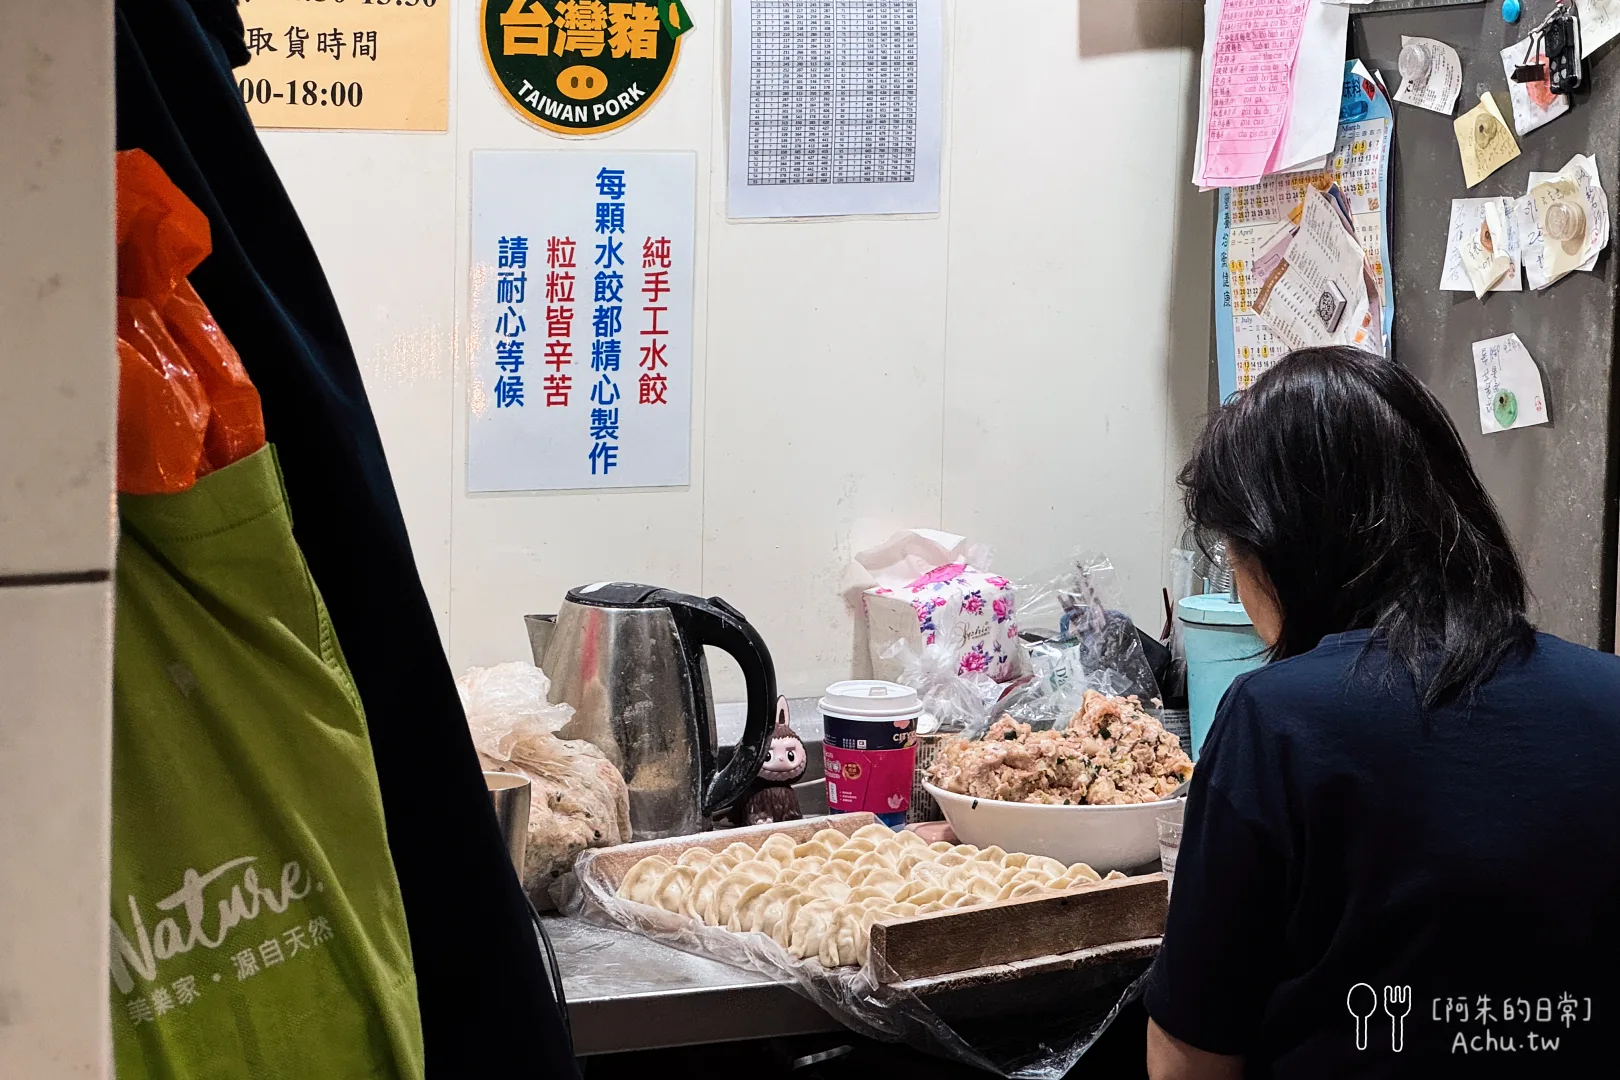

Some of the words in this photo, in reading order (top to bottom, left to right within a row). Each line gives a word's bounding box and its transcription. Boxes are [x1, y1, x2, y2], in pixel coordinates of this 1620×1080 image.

[247, 26, 378, 61] 取貨時間
[500, 0, 660, 60] 台灣豬
[517, 79, 588, 122] TAIWAN
[592, 81, 646, 121] PORK
[494, 236, 528, 408] 請耐心等候
[543, 236, 576, 407] 粒粒皆辛苦
[588, 167, 626, 475] 每顆水餃都精心製作
[638, 236, 672, 405] 純手工水餃
